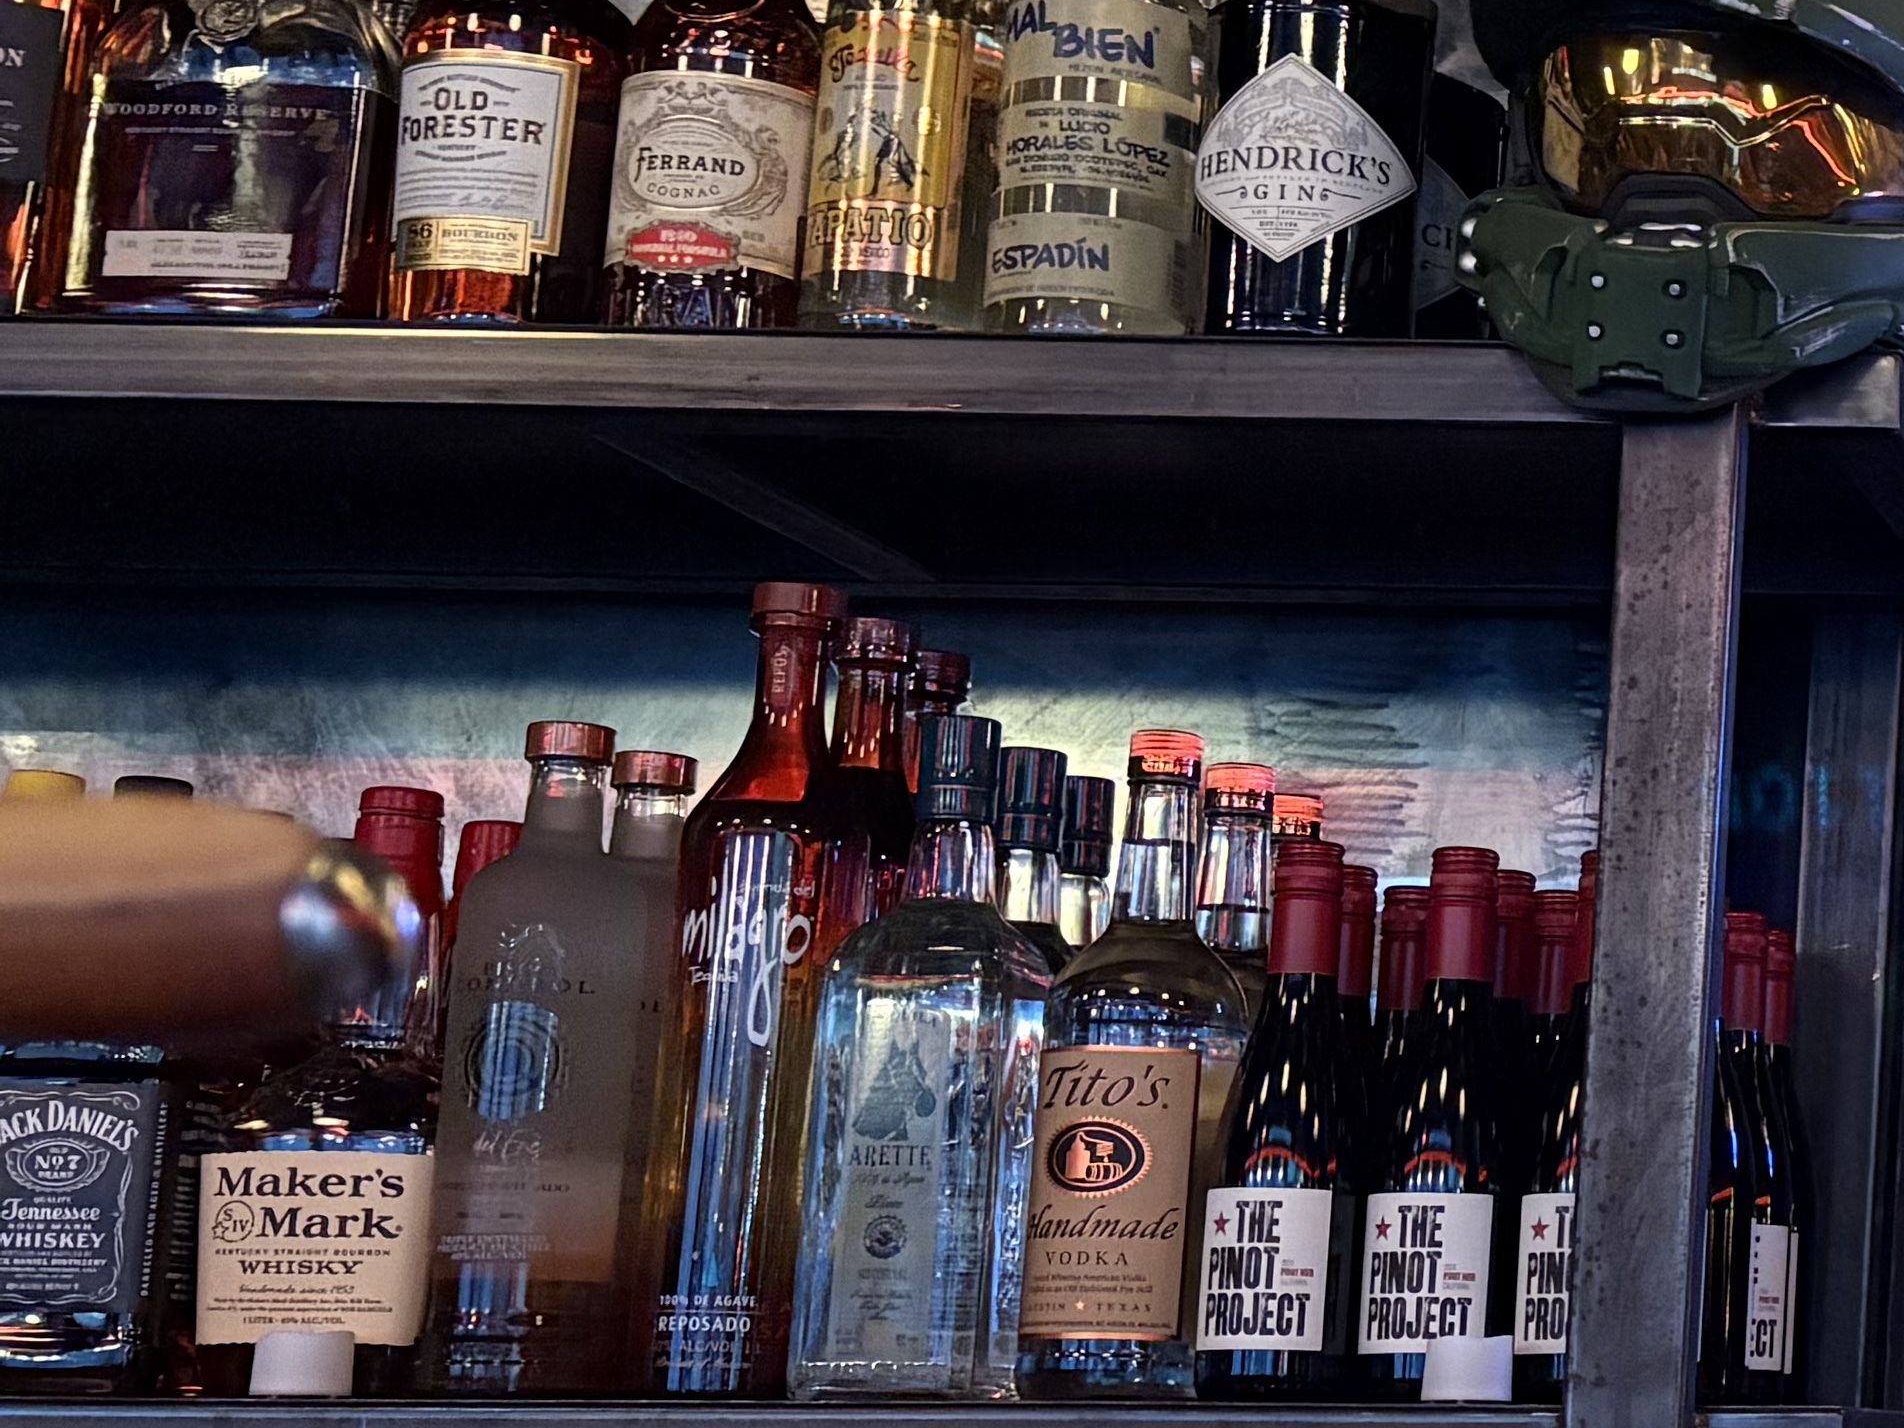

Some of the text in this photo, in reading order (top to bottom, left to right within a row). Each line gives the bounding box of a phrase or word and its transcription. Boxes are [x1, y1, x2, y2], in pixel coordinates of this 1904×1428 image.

[1054, 24, 1157, 69] BIEN
[434, 87, 488, 111] OLD
[401, 115, 546, 145] FORESTER
[1058, 120, 1111, 135] LUCIO
[635, 146, 746, 183] FERRAND
[1200, 146, 1392, 186] HENDRICK'S
[647, 182, 720, 199] COGNAC
[1253, 184, 1316, 202] GIN
[442, 228, 519, 242] BOURBON
[810, 204, 933, 251] APATIO
[992, 237, 1110, 272] ESPADÍN
[682, 876, 813, 1047] milagro
[1042, 1060, 1162, 1110] Tito's
[47, 1100, 139, 1151] DANIEL'S
[848, 1144, 932, 1167] ARETTE
[213, 1167, 404, 1198] Maker's
[1, 1198, 101, 1221] Tennessee
[256, 1207, 400, 1239] Mark
[1028, 1203, 1181, 1241] Handmade
[1236, 1200, 1283, 1244] THE
[1398, 1205, 1445, 1248] THE
[0, 1232, 106, 1249] WHISKEY
[238, 1260, 363, 1275] WHISKY
[1045, 1251, 1128, 1266] VODKA
[1208, 1247, 1279, 1290] PINOT
[1372, 1250, 1442, 1294] PINOT
[658, 1314, 751, 1334] REPOSADO
[1205, 1292, 1310, 1337] PROJECT
[1367, 1297, 1472, 1341] PROJECT
